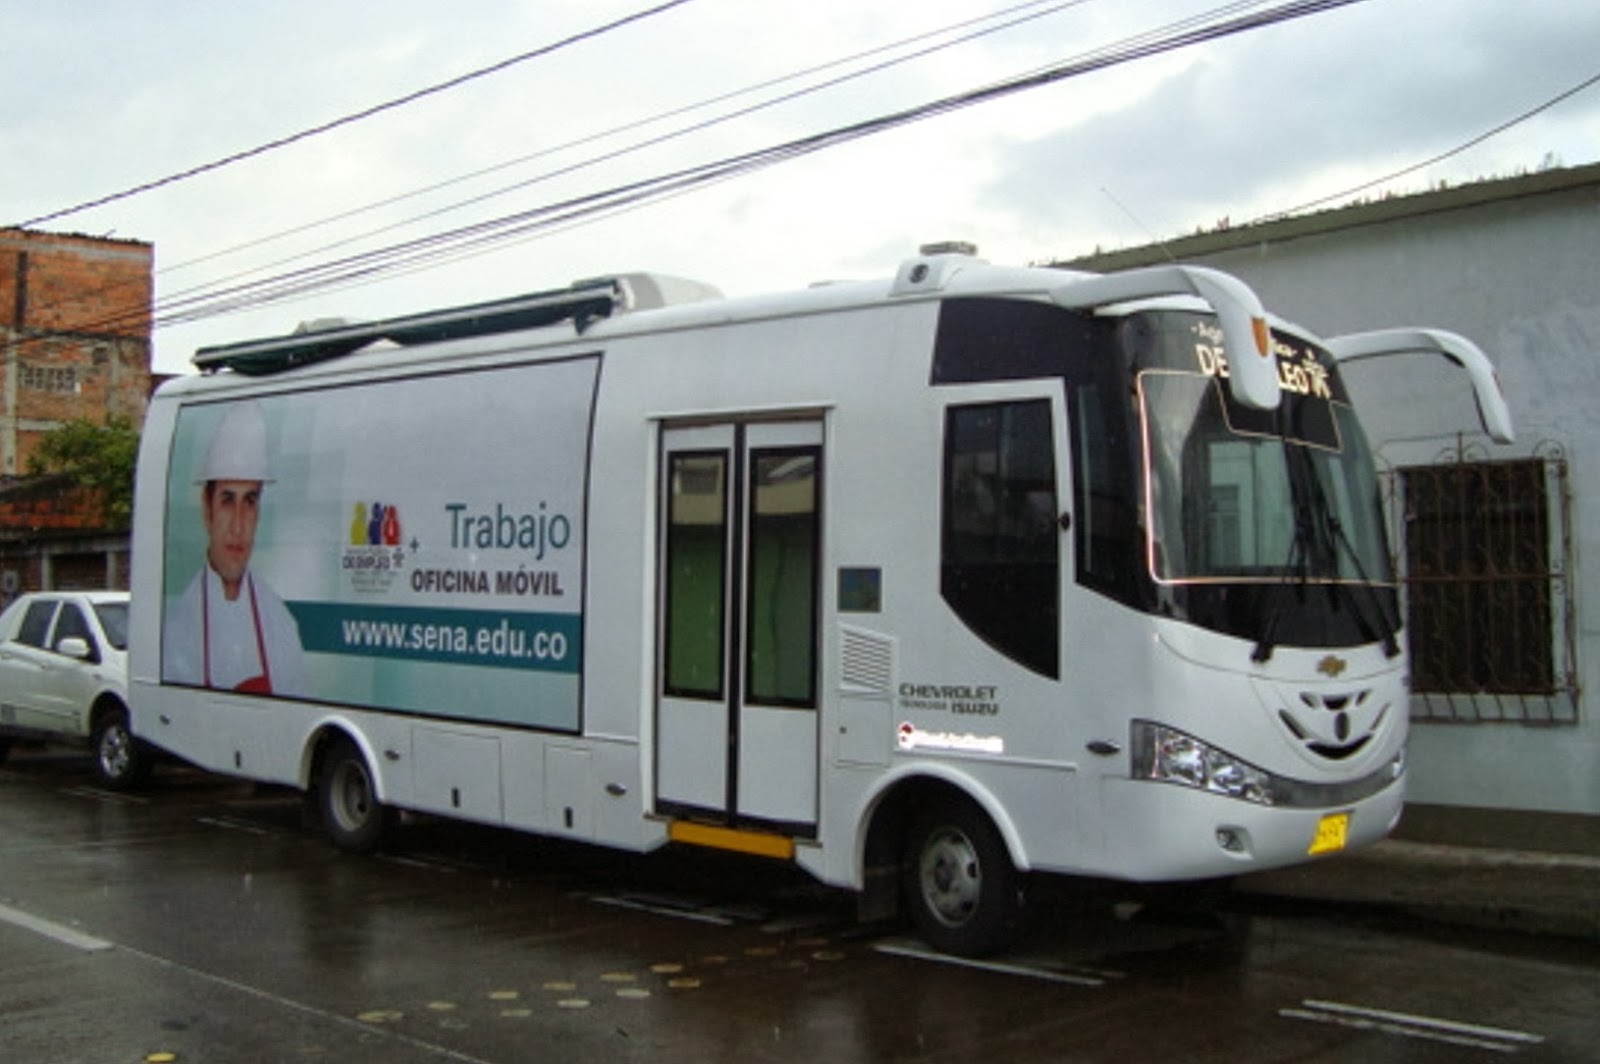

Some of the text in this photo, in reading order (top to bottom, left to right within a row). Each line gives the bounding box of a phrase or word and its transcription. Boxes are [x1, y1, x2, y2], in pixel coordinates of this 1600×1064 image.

[445, 501, 571, 561] Trabajo
[411, 564, 564, 596] OFICINA MÓVIL
[342, 618, 568, 662] www.sena.edu.co
[899, 682, 998, 699] CHEVROLET
[951, 702, 999, 715] ISUZU
